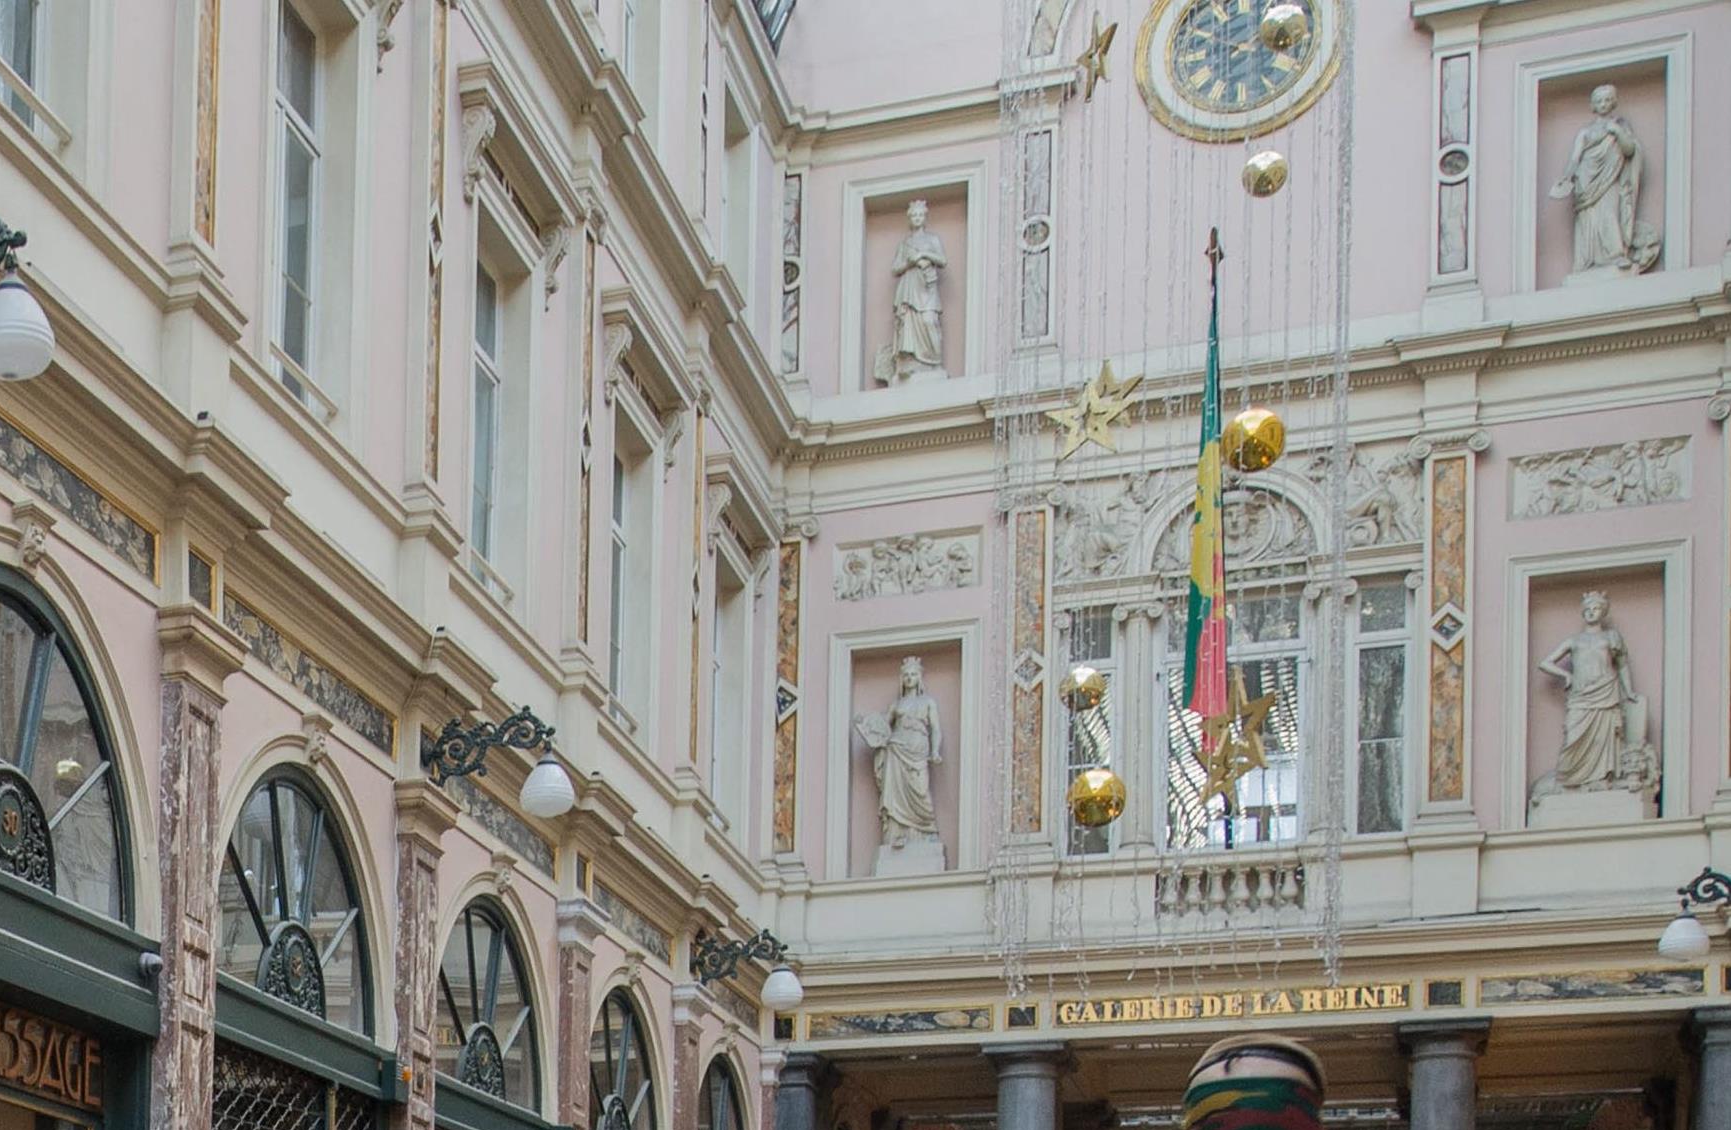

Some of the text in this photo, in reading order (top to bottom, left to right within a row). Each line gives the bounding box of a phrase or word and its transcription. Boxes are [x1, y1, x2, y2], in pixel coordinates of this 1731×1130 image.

[1059, 996, 1194, 1024] GALERIE
[1200, 993, 1244, 1017] DE
[1251, 990, 1295, 1015] LA
